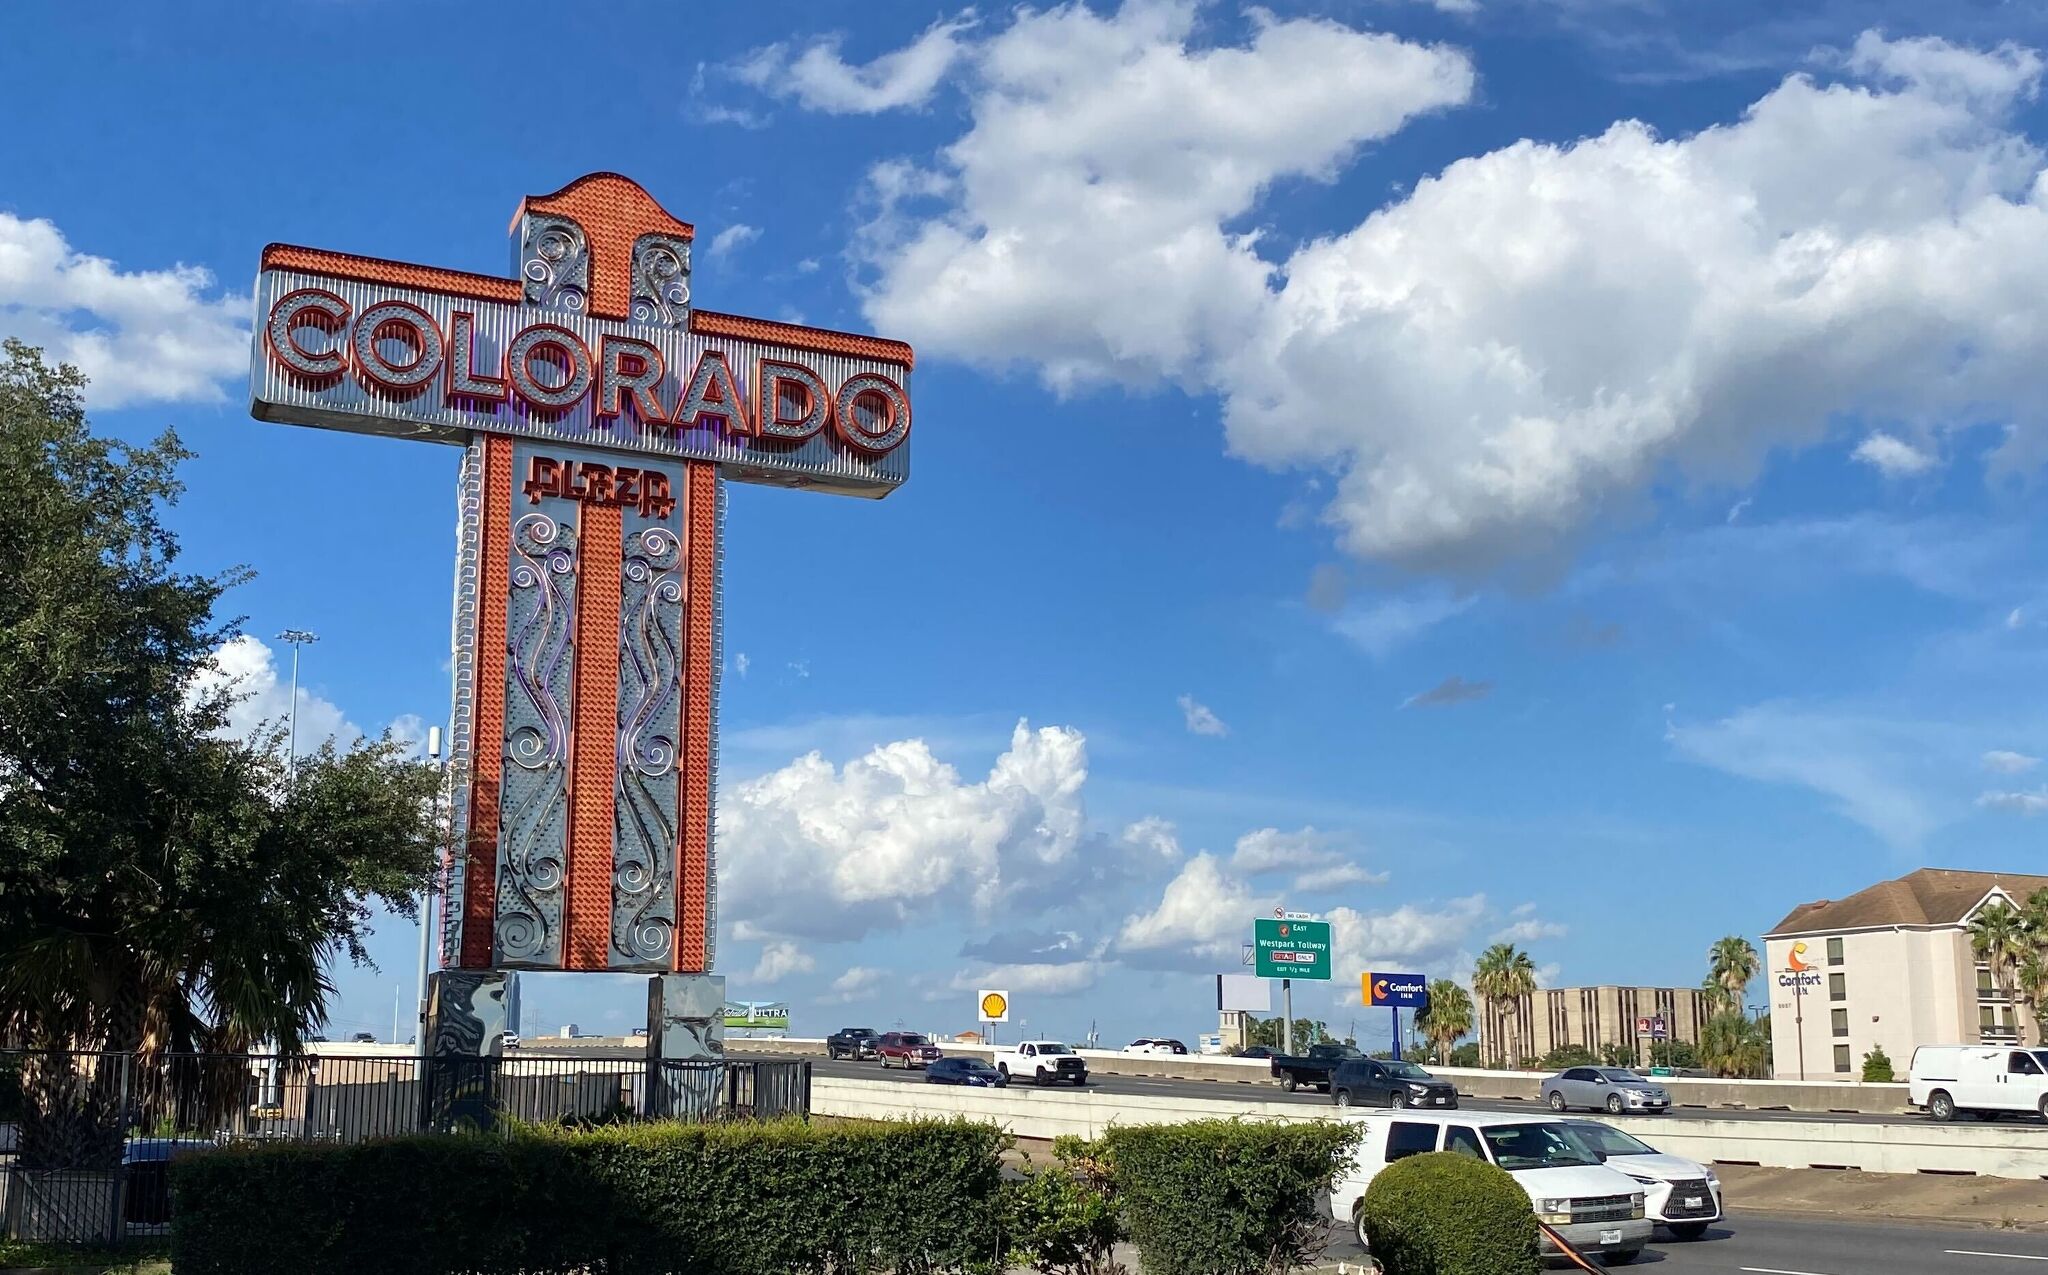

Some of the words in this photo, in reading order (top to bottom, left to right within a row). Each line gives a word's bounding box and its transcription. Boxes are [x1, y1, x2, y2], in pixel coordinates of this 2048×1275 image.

[263, 288, 912, 456] COLORADO
[522, 456, 677, 519] PLAZA
[1259, 939, 1295, 949] Westpark
[1297, 941, 1326, 951] Tollway
[1779, 972, 1821, 986] Comfort
[1390, 983, 1423, 992] Comfort
[754, 1008, 787, 1017] ULTRA
